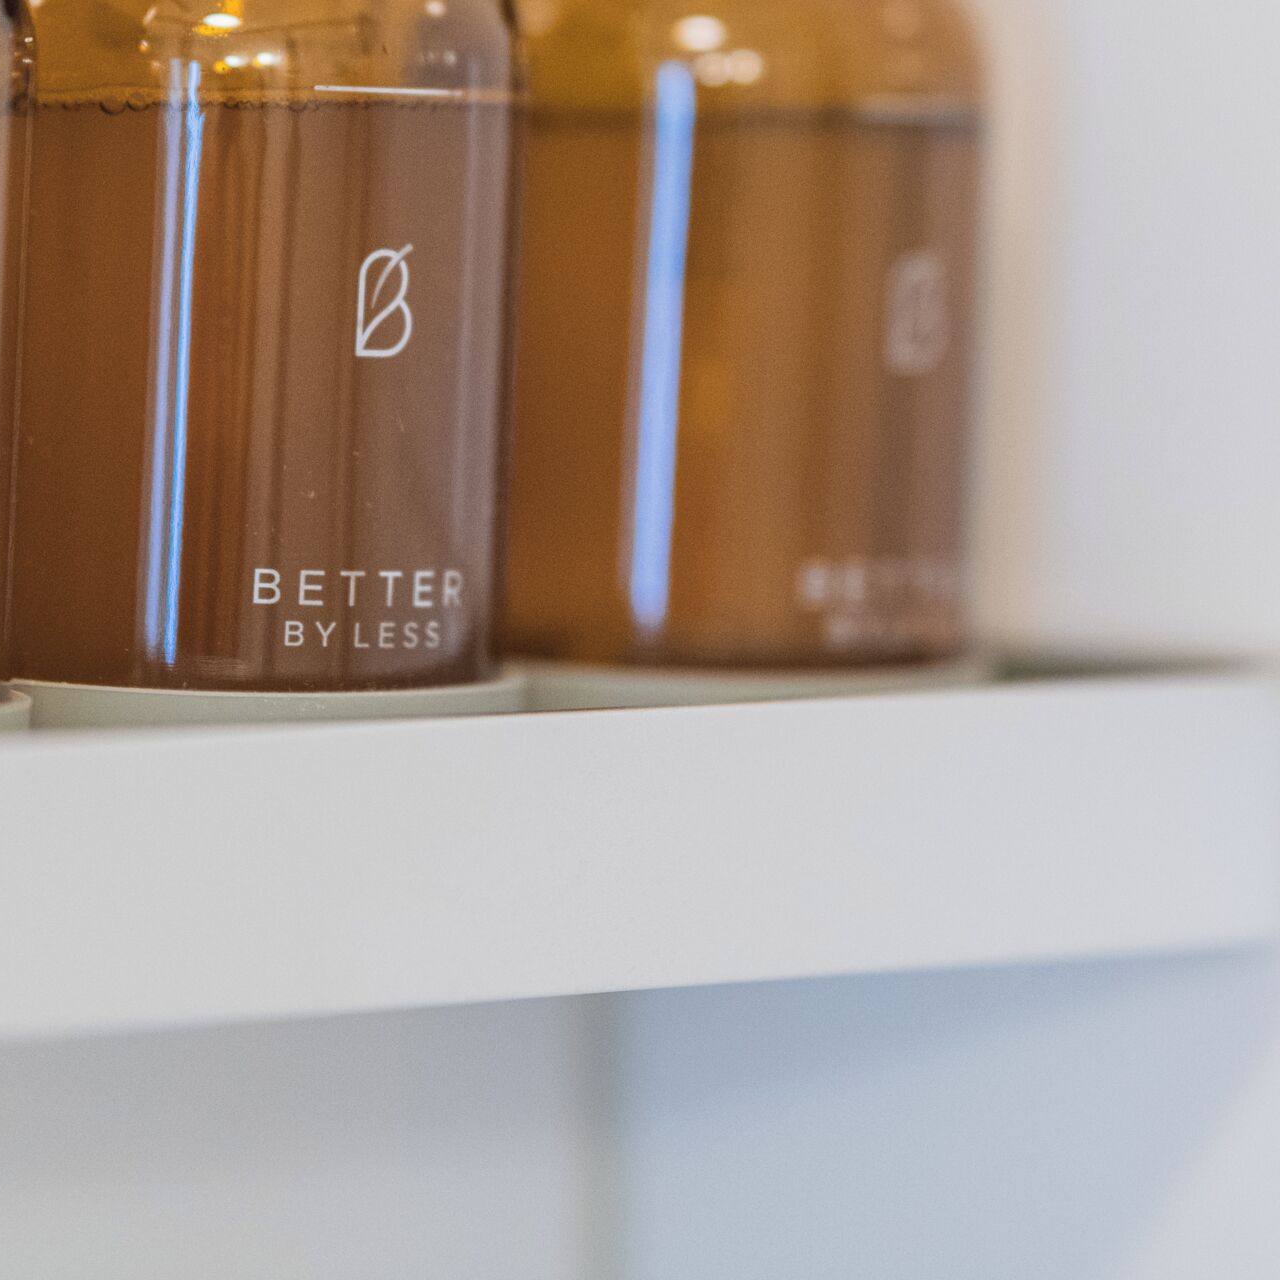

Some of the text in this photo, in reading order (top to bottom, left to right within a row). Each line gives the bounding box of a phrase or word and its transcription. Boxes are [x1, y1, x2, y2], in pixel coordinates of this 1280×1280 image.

[251, 568, 464, 607] BETTER
[283, 620, 441, 650] BY LESS
